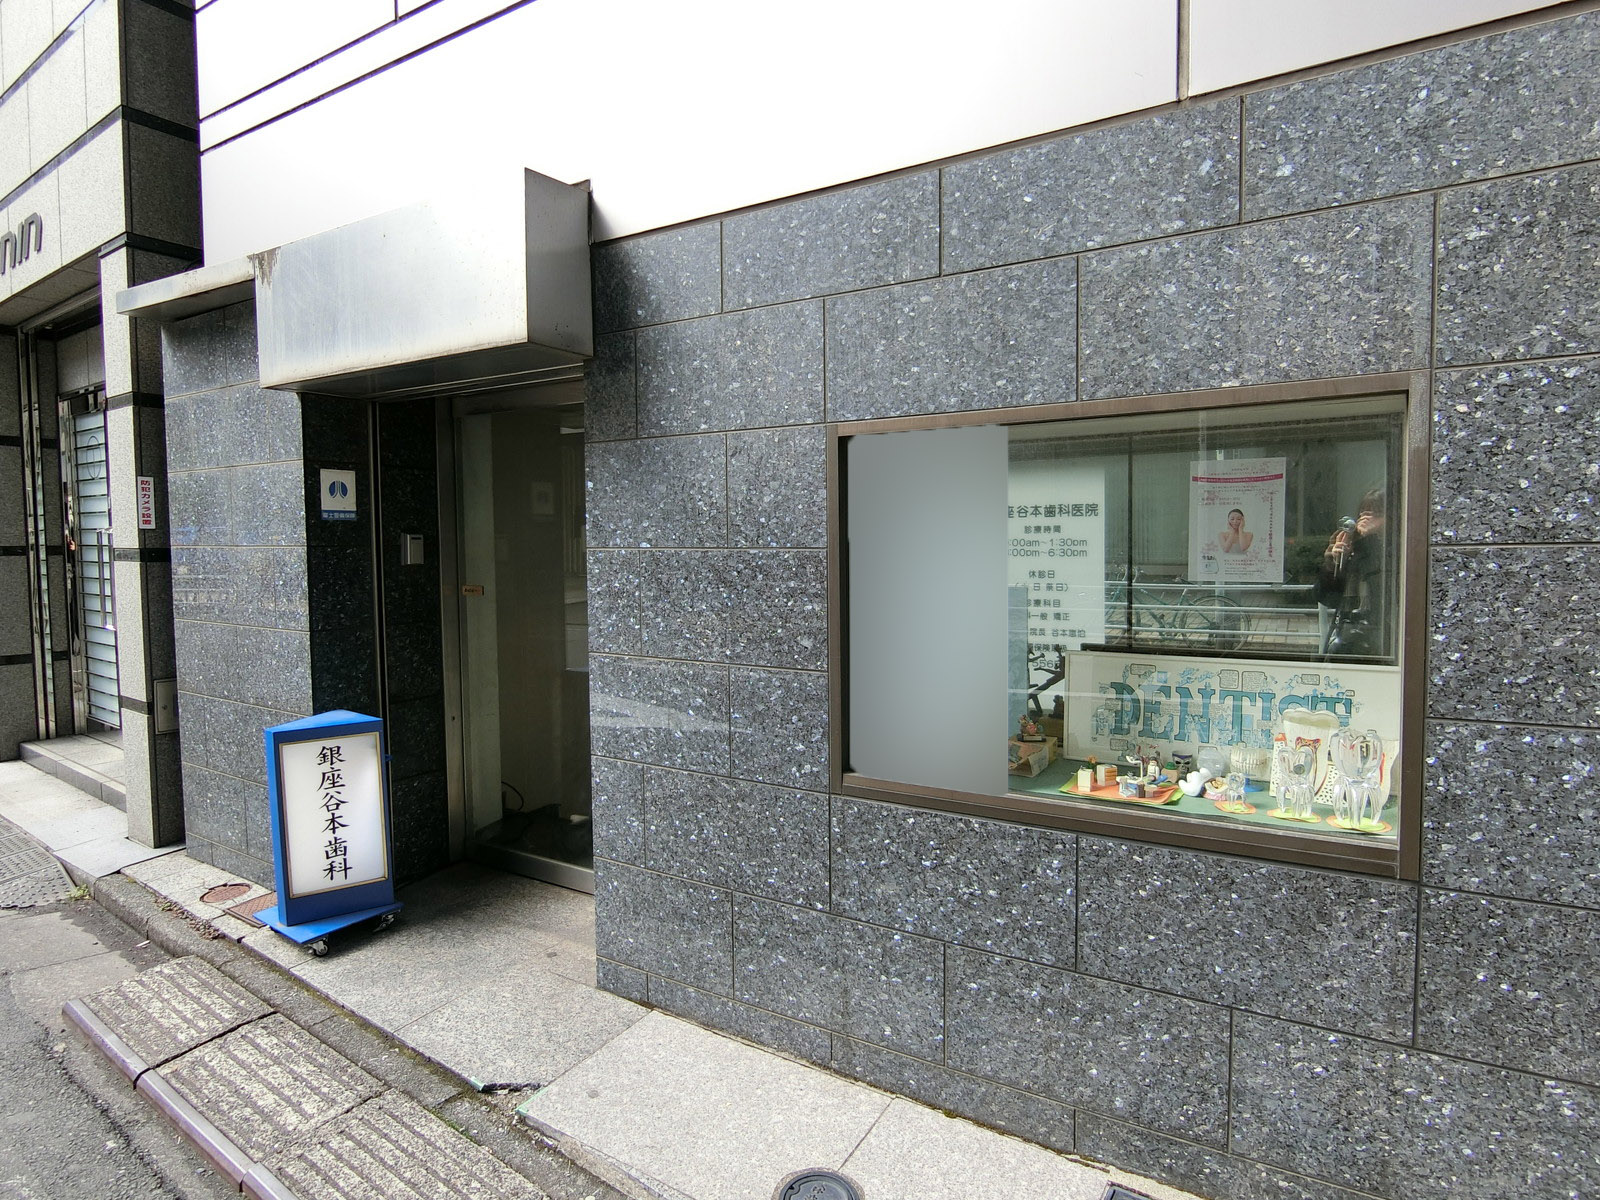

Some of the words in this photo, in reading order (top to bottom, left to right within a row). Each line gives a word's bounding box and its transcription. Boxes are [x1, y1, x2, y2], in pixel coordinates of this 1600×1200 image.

[140, 480, 152, 525] 防犯カメラ設置
[1024, 525, 1061, 534] 診療時間
[1028, 570, 1055, 579] 休診日
[1028, 611, 1048, 620] 一般
[316, 745, 353, 881] 銀座谷本歯科
